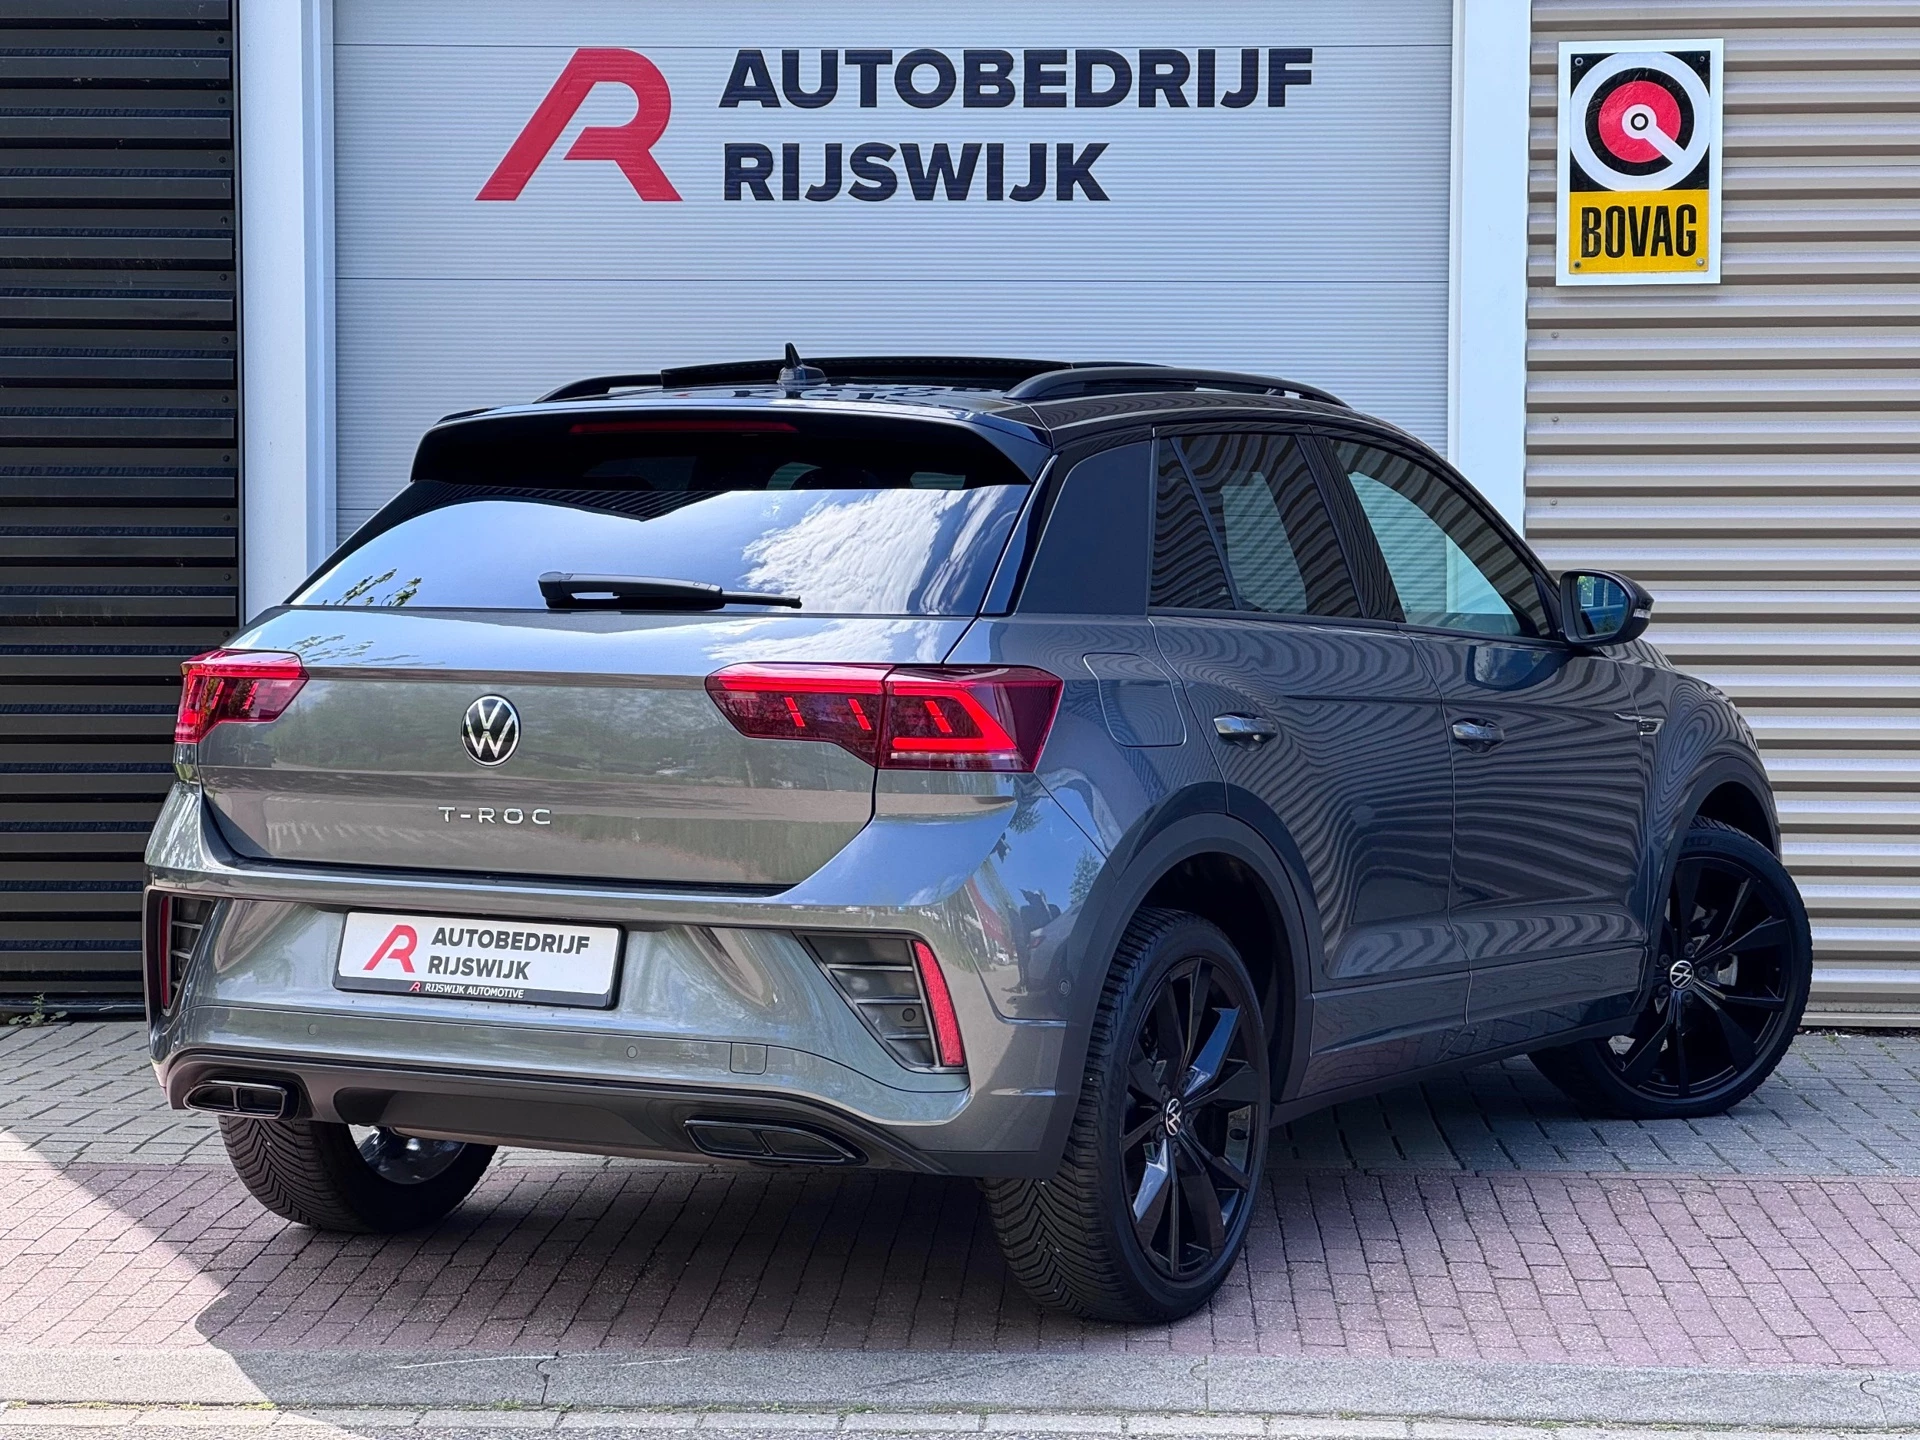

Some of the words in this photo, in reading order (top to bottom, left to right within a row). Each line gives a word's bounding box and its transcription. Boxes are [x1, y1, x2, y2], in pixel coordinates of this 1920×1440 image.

[719, 48, 1313, 109] AUTOBEDRIJF
[724, 143, 1110, 201] RIJSWIJK
[1580, 204, 1697, 258] BOVAG
[438, 806, 552, 825] T-ROC
[431, 927, 590, 955] AUTOBEDRIJF
[427, 955, 531, 980] RIJSWIJK
[425, 983, 465, 994] RIJSWIJK
[466, 987, 524, 999] AUTOMOTIVE
